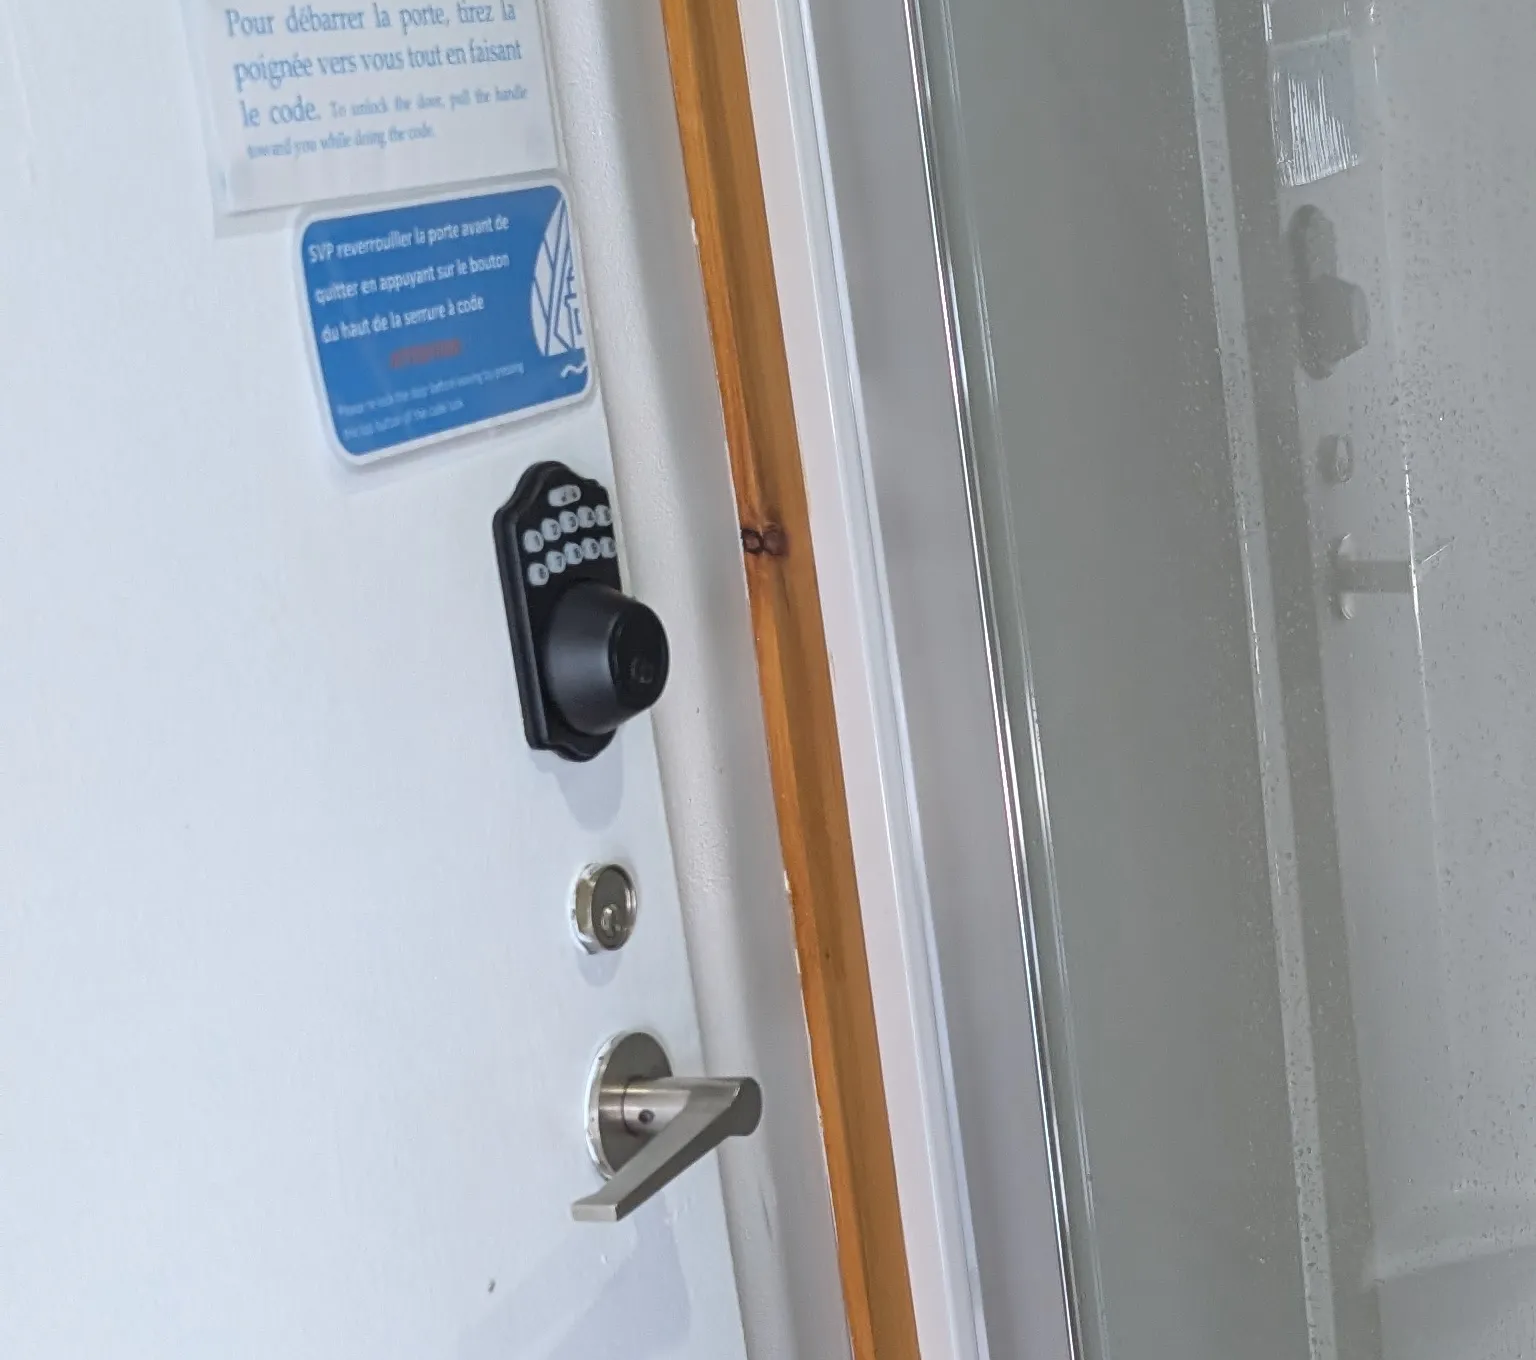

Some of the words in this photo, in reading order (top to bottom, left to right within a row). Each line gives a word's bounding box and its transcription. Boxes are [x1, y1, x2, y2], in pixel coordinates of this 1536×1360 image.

[225, 7, 275, 37] Pour
[285, 5, 365, 34] débarrer
[372, 2, 391, 29] la
[400, 3, 450, 35] porte,
[456, 0, 493, 24] tirez
[233, 55, 312, 92] poignée
[319, 54, 357, 76] vers
[360, 50, 403, 72] vous
[407, 47, 441, 69] tout
[446, 47, 467, 65] en
[468, 38, 522, 63] faisant
[240, 101, 260, 128] le
[269, 95, 321, 125] code.
[308, 242, 334, 263] SVP
[414, 227, 425, 244] la
[427, 223, 459, 246] porte
[461, 216, 493, 237] avant
[495, 213, 510, 232] de
[315, 282, 359, 305] quitter
[361, 279, 377, 295] en
[379, 265, 435, 293] appuyant
[436, 264, 455, 280] sur
[456, 258, 468, 276] le
[468, 252, 510, 273] bouton
[321, 324, 340, 344] du
[340, 319, 371, 338] haut
[371, 313, 389, 333] de
[390, 311, 403, 329] la
[456, 294, 485, 314] code
